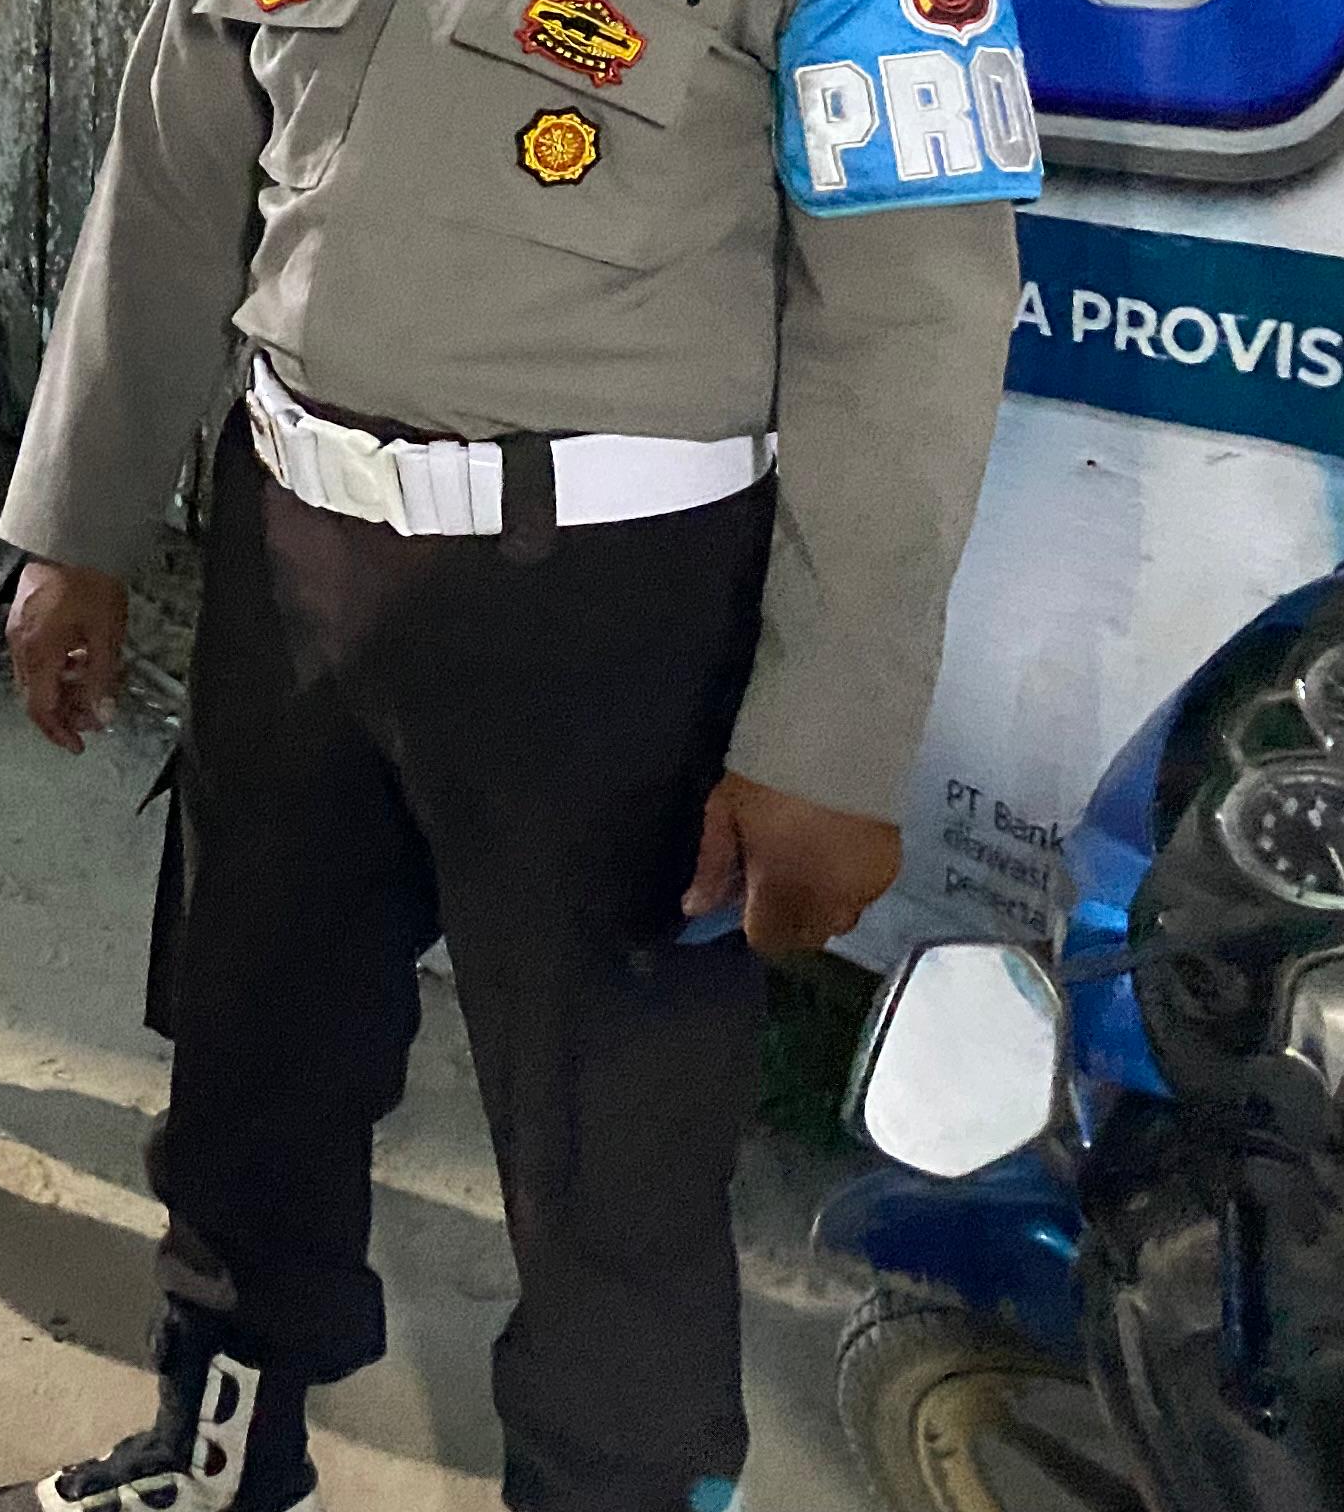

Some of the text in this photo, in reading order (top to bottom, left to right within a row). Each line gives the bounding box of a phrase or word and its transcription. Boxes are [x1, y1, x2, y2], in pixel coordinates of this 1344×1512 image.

[794, 46, 1042, 191] PRO
[1072, 288, 1343, 387] PROVIS
[947, 779, 1064, 856] PT Bank
